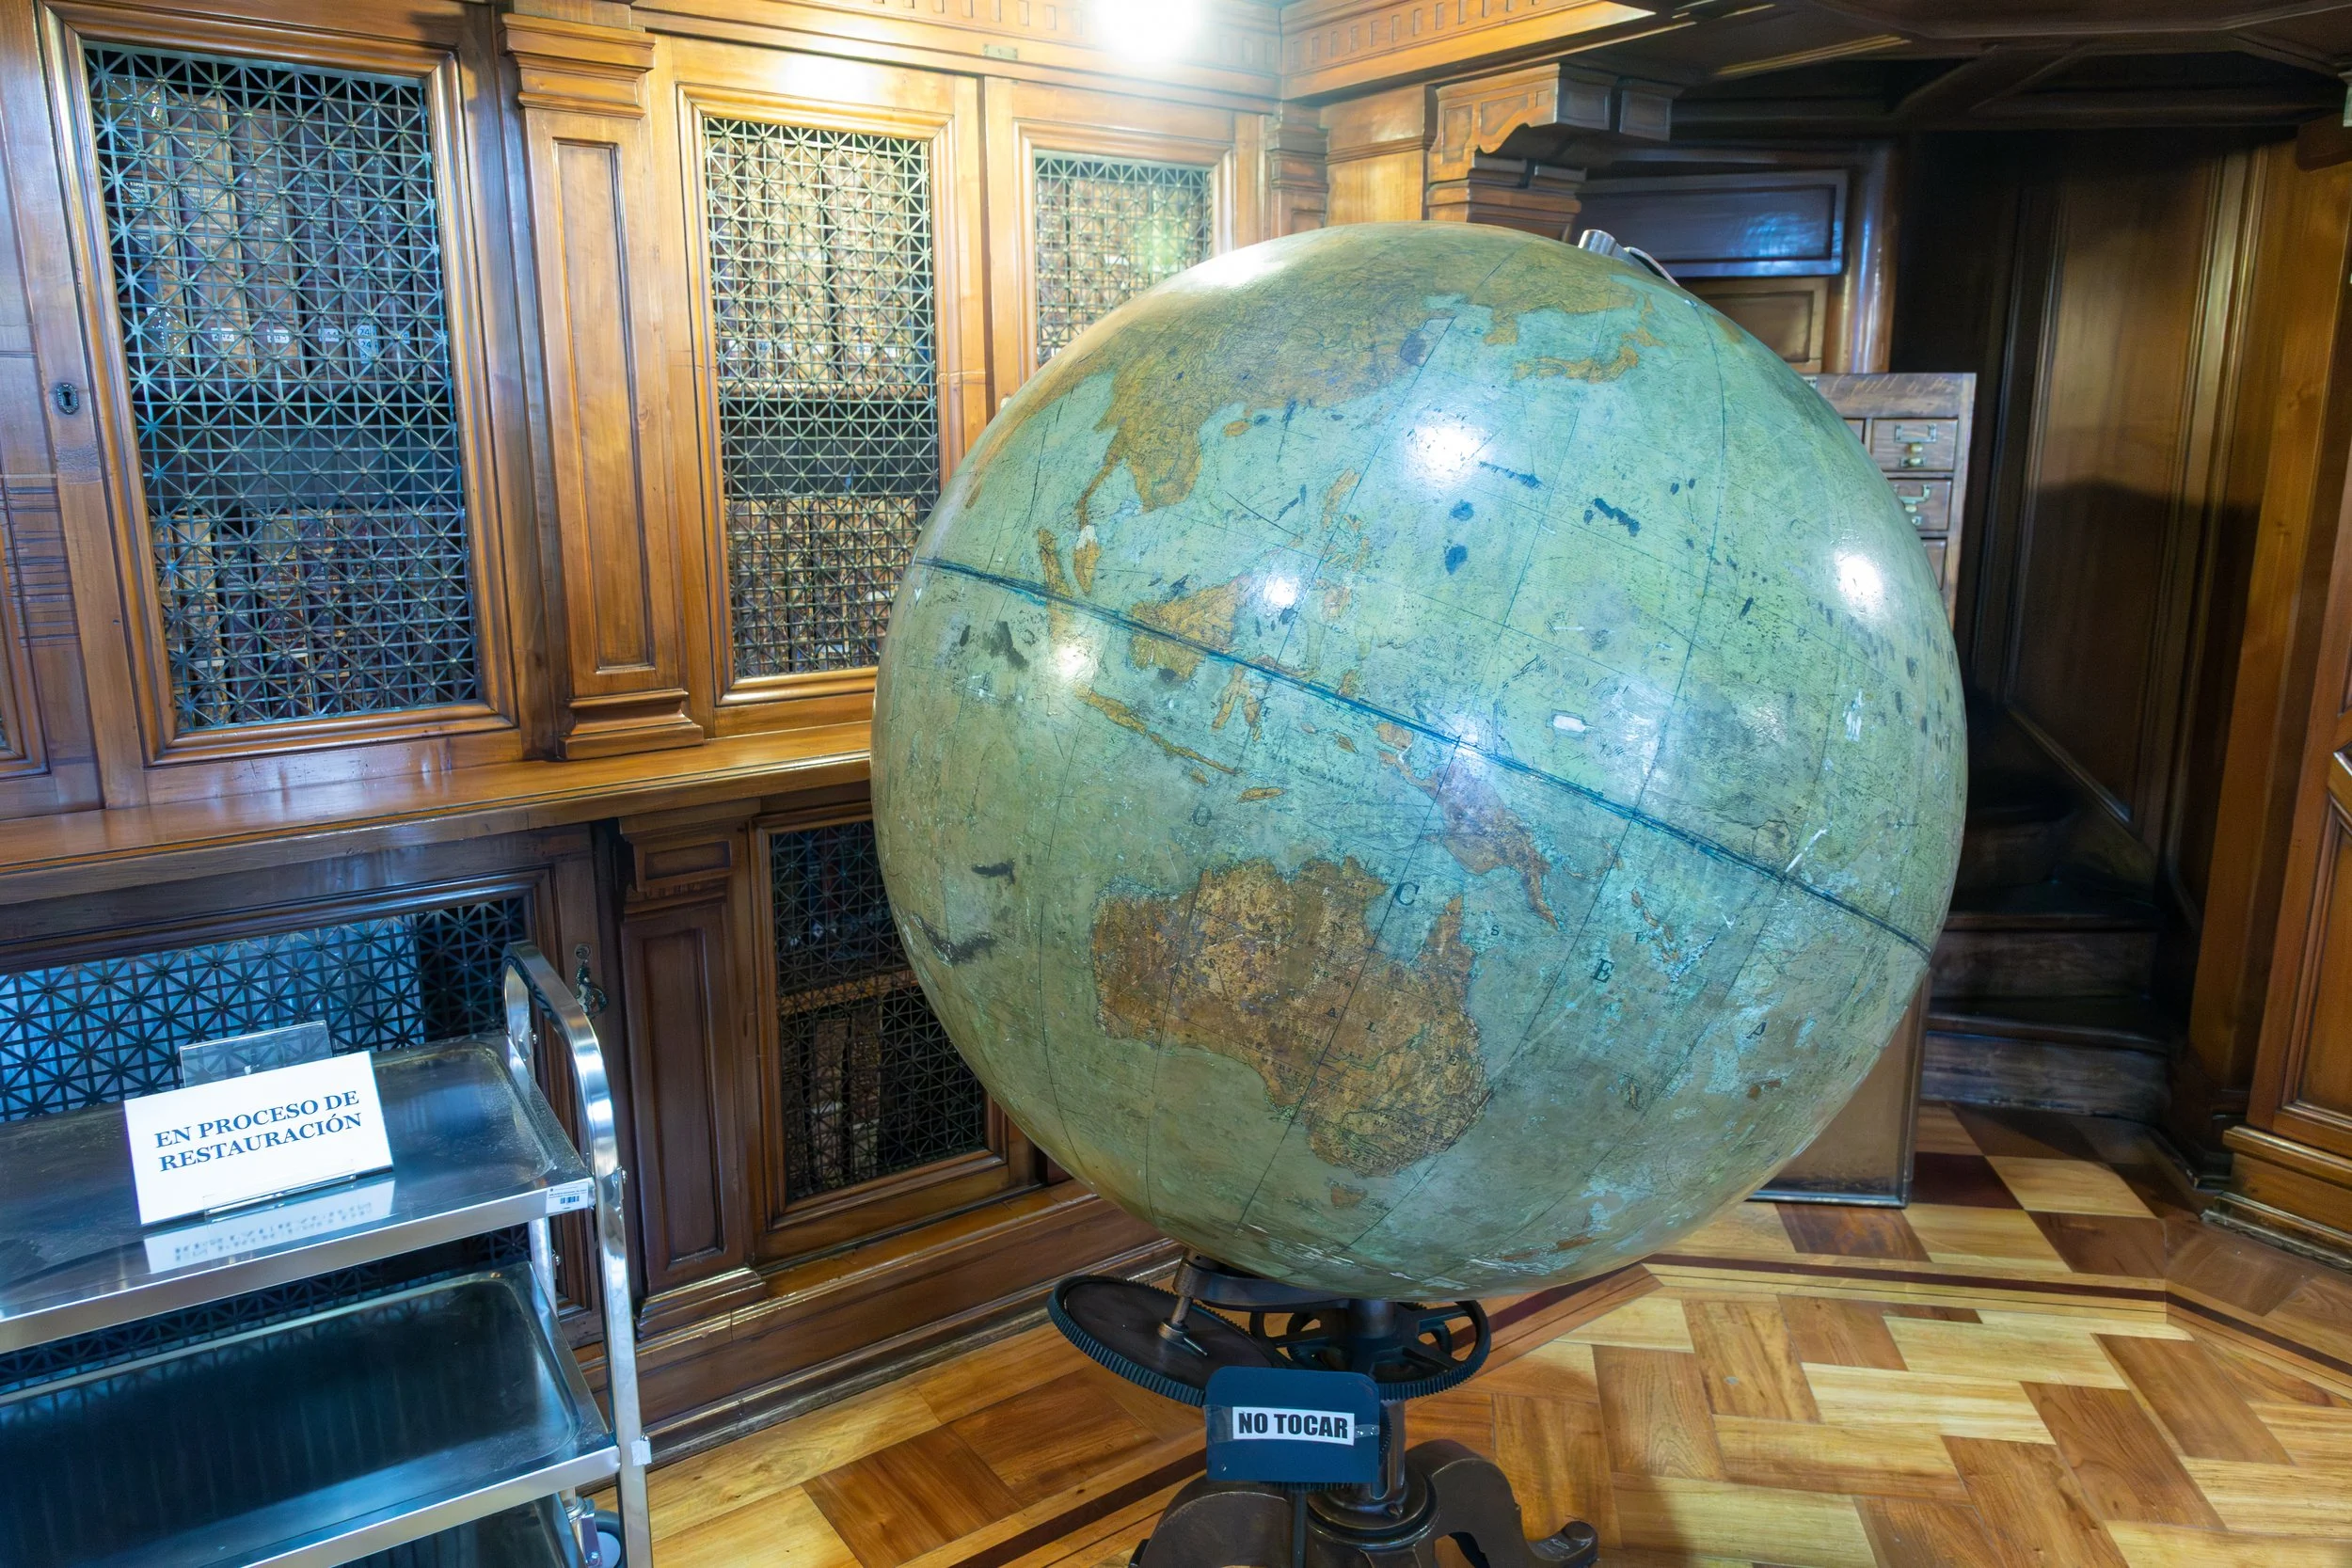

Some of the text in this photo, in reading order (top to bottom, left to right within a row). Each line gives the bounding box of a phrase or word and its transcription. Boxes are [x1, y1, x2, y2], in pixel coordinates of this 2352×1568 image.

[1395, 881, 1420, 905] C
[1594, 958, 1615, 984] E
[1747, 1022, 1767, 1039] A
[154, 1090, 359, 1148] EN PROCESO DE
[158, 1112, 362, 1172] RESTAURACIÓN
[1238, 1413, 1348, 1439] NO TOCAR
